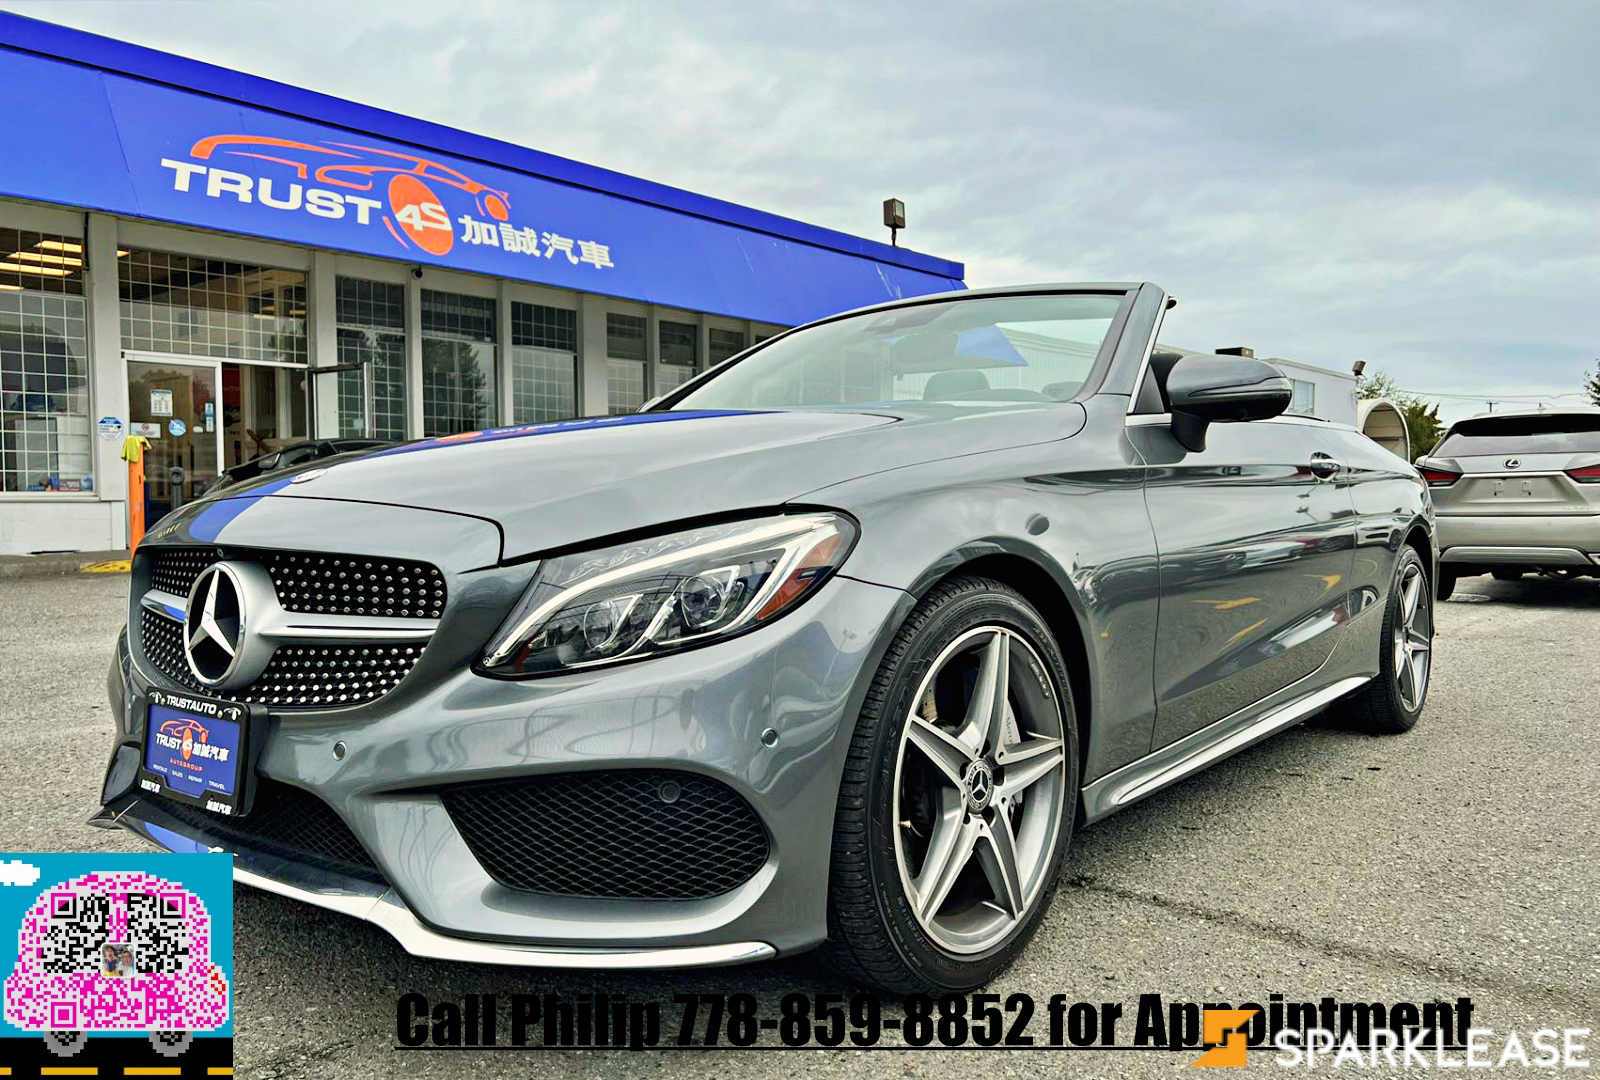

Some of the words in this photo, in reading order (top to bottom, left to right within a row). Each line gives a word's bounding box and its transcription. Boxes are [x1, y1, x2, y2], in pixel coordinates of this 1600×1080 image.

[161, 158, 381, 225] TRUST
[395, 202, 452, 231] 4S
[458, 215, 614, 269] 加誠汽車
[167, 695, 217, 714] TRUSTAUTO
[156, 733, 182, 750] TRUST
